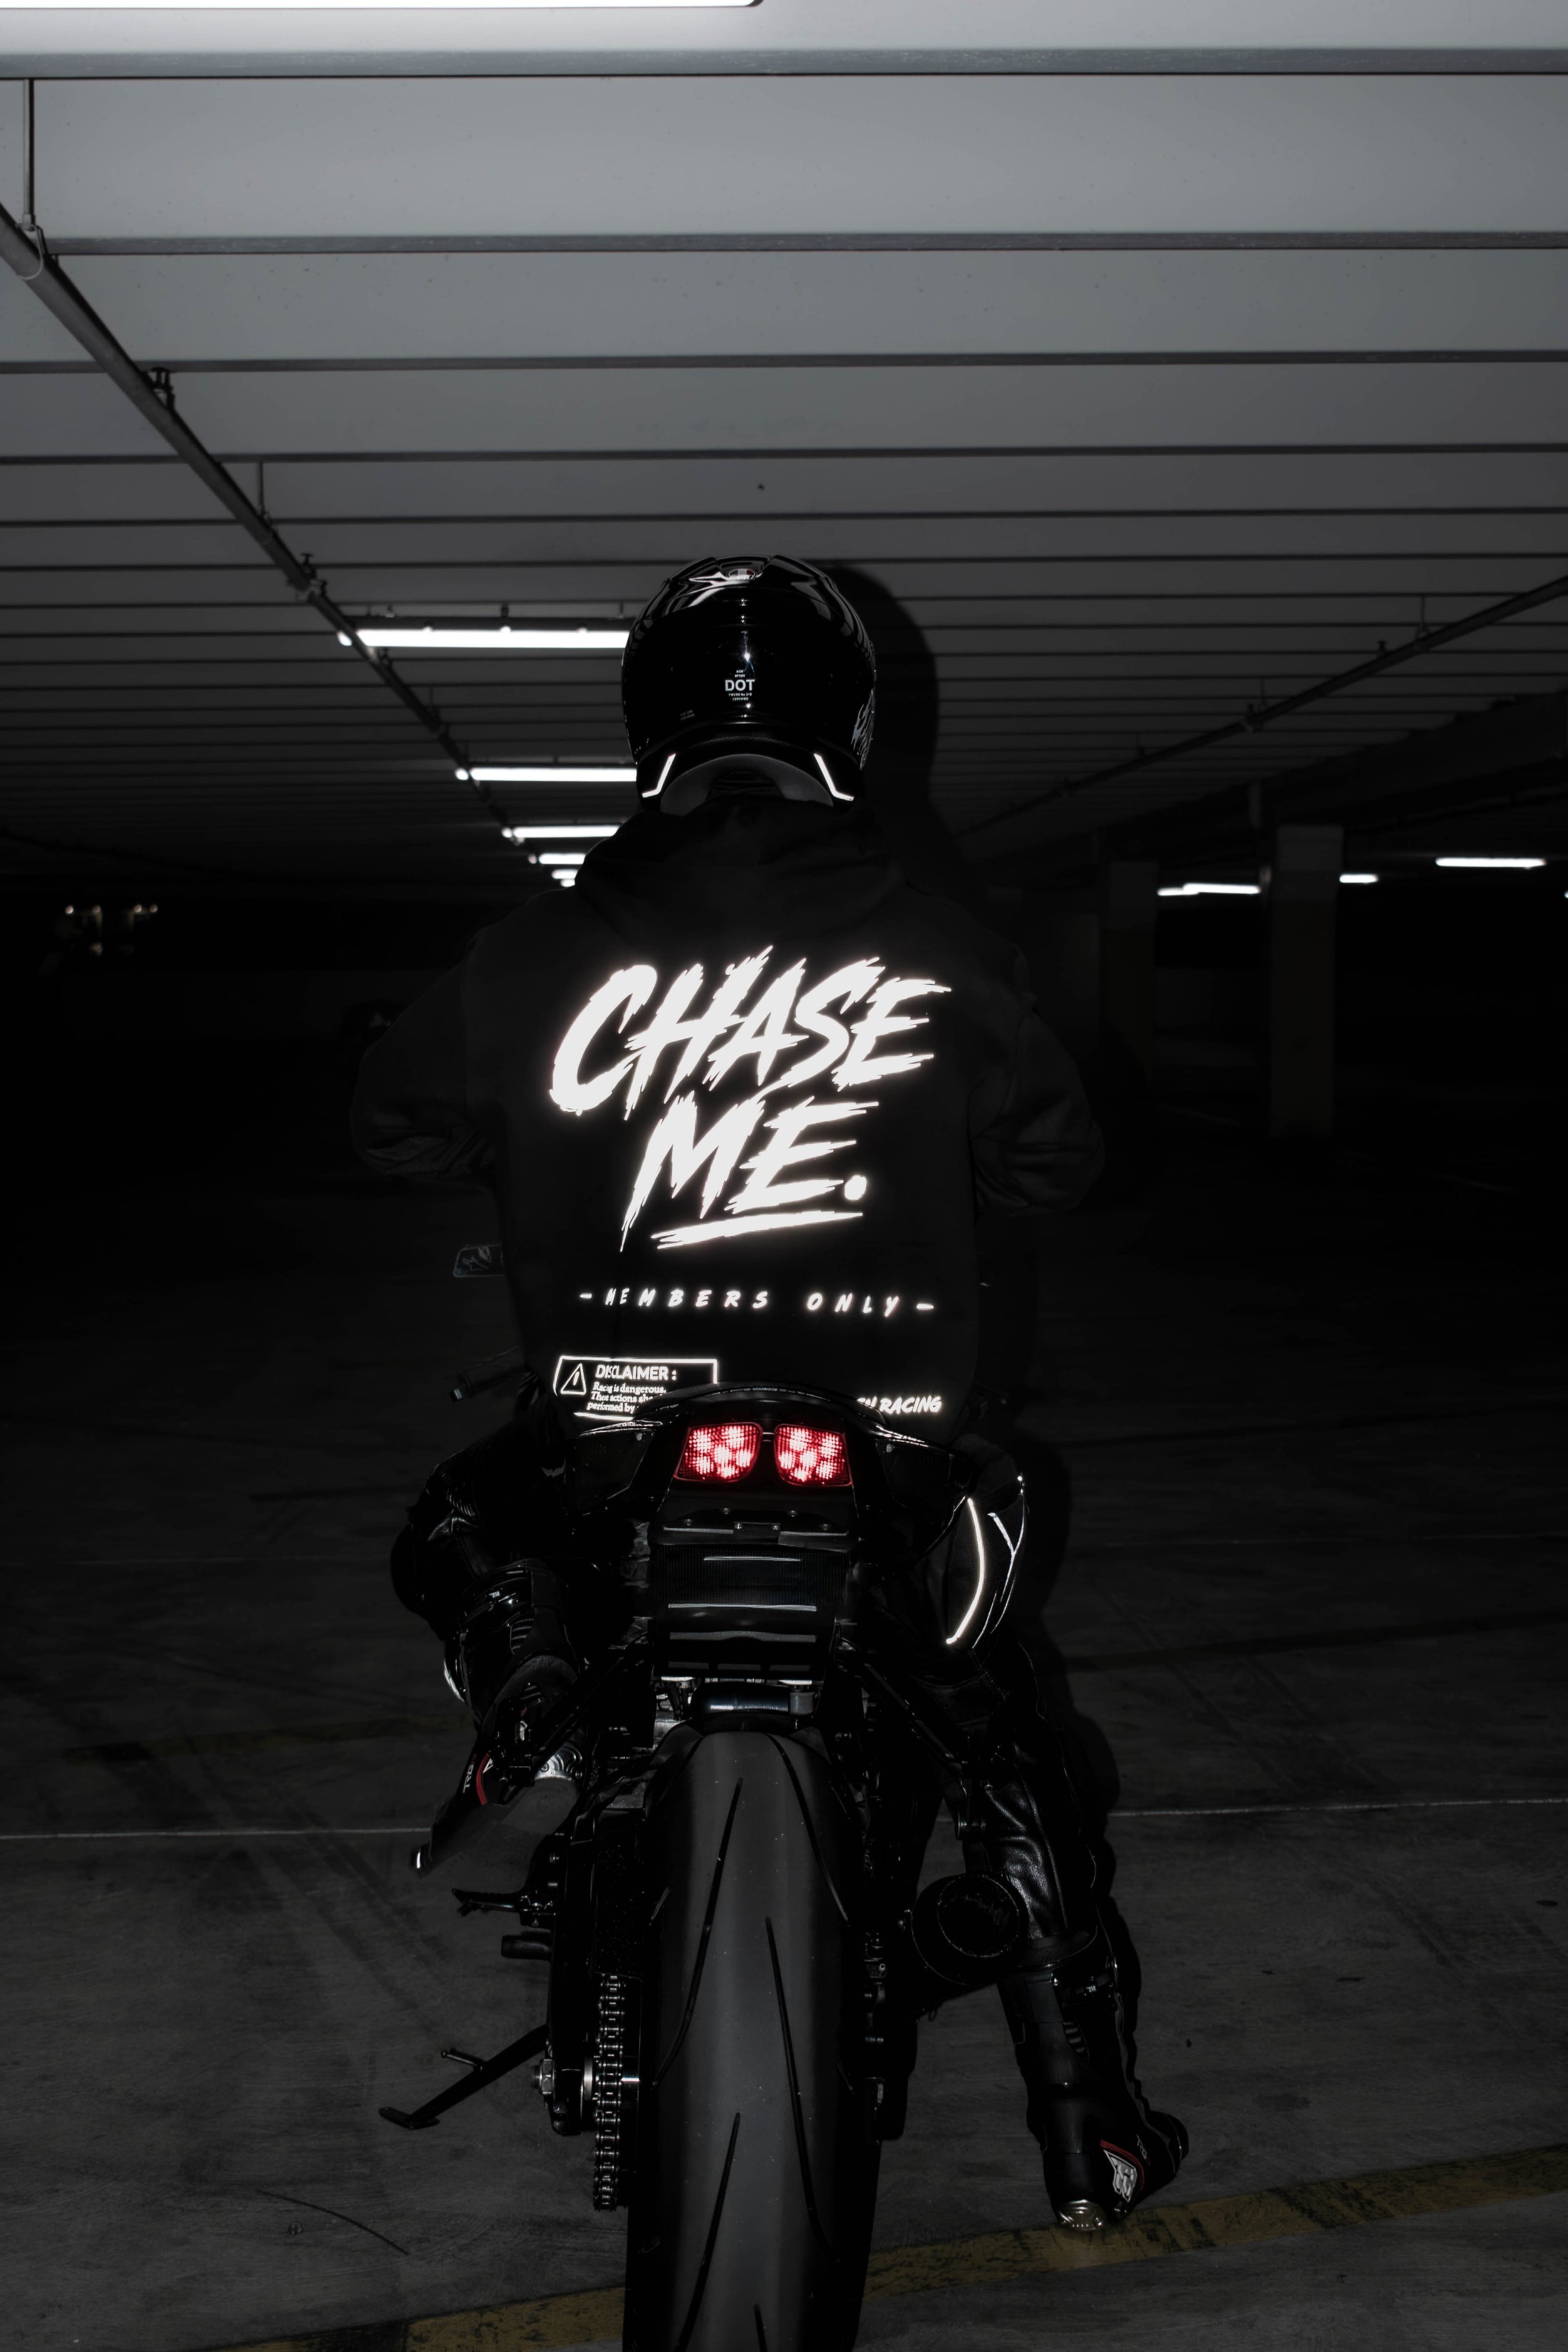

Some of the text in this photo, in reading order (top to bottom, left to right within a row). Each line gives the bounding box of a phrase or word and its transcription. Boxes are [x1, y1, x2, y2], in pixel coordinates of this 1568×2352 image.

[725, 679, 755, 691] DOT
[549, 945, 952, 1121] CHASE
[619, 1090, 880, 1253] ME.
[604, 1288, 899, 1317] MEMBERS ONLY
[613, 1384, 619, 1393] is
[624, 1403, 636, 1414] by
[879, 1395, 942, 1415] RACING
